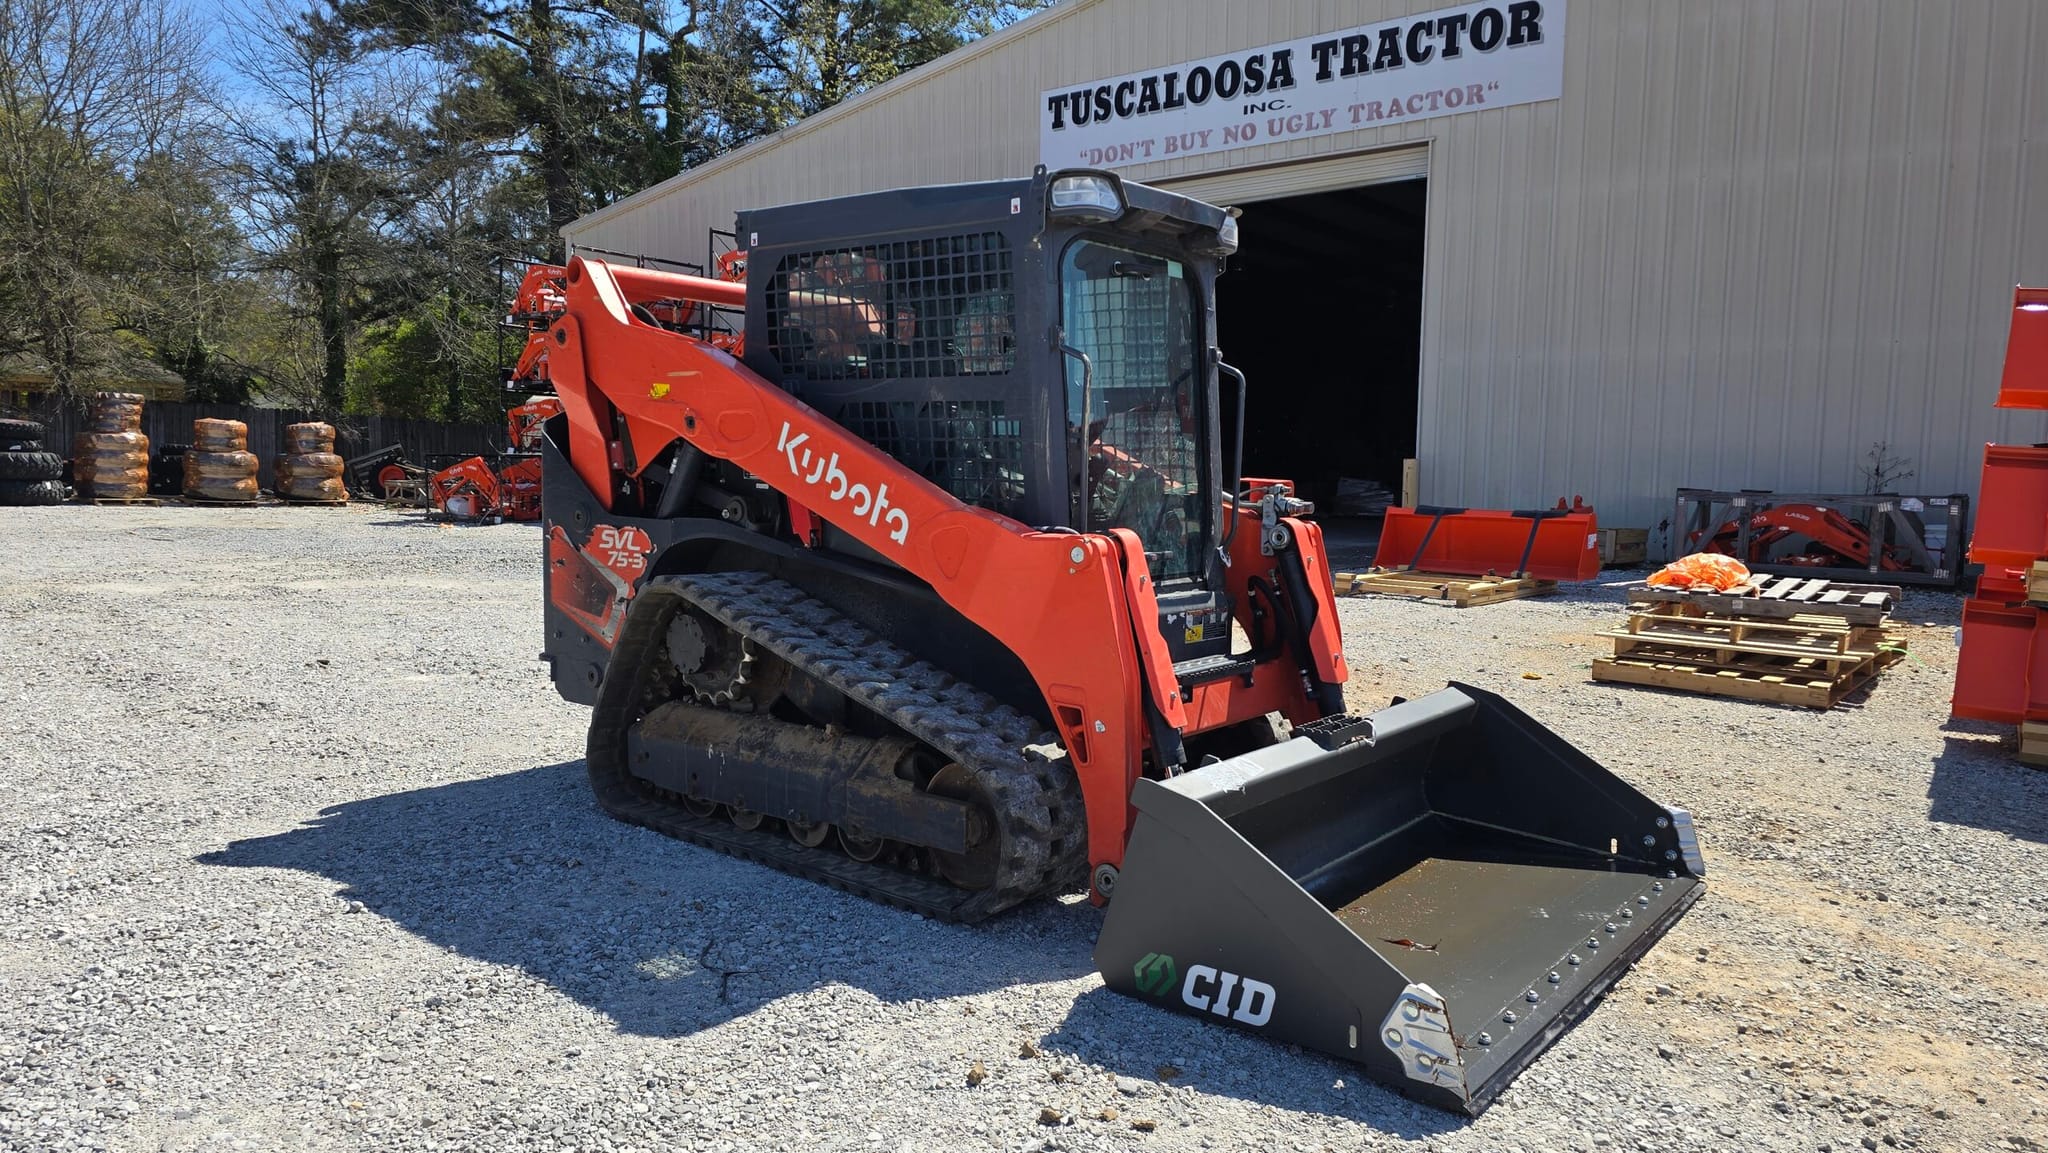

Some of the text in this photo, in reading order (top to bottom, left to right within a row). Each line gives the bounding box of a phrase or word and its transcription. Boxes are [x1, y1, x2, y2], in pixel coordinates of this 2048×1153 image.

[1048, 0, 1543, 130] TUSCALOOSA TRACTOR
[1243, 99, 1292, 115] INC.
[1164, 129, 1213, 154] BUY
[1223, 122, 1257, 145] NO
[1267, 108, 1337, 137] UGLY
[777, 421, 908, 545] Kubota
[599, 529, 640, 551] SVL
[607, 551, 643, 569] 75-3
[1182, 964, 1276, 1027] CID
